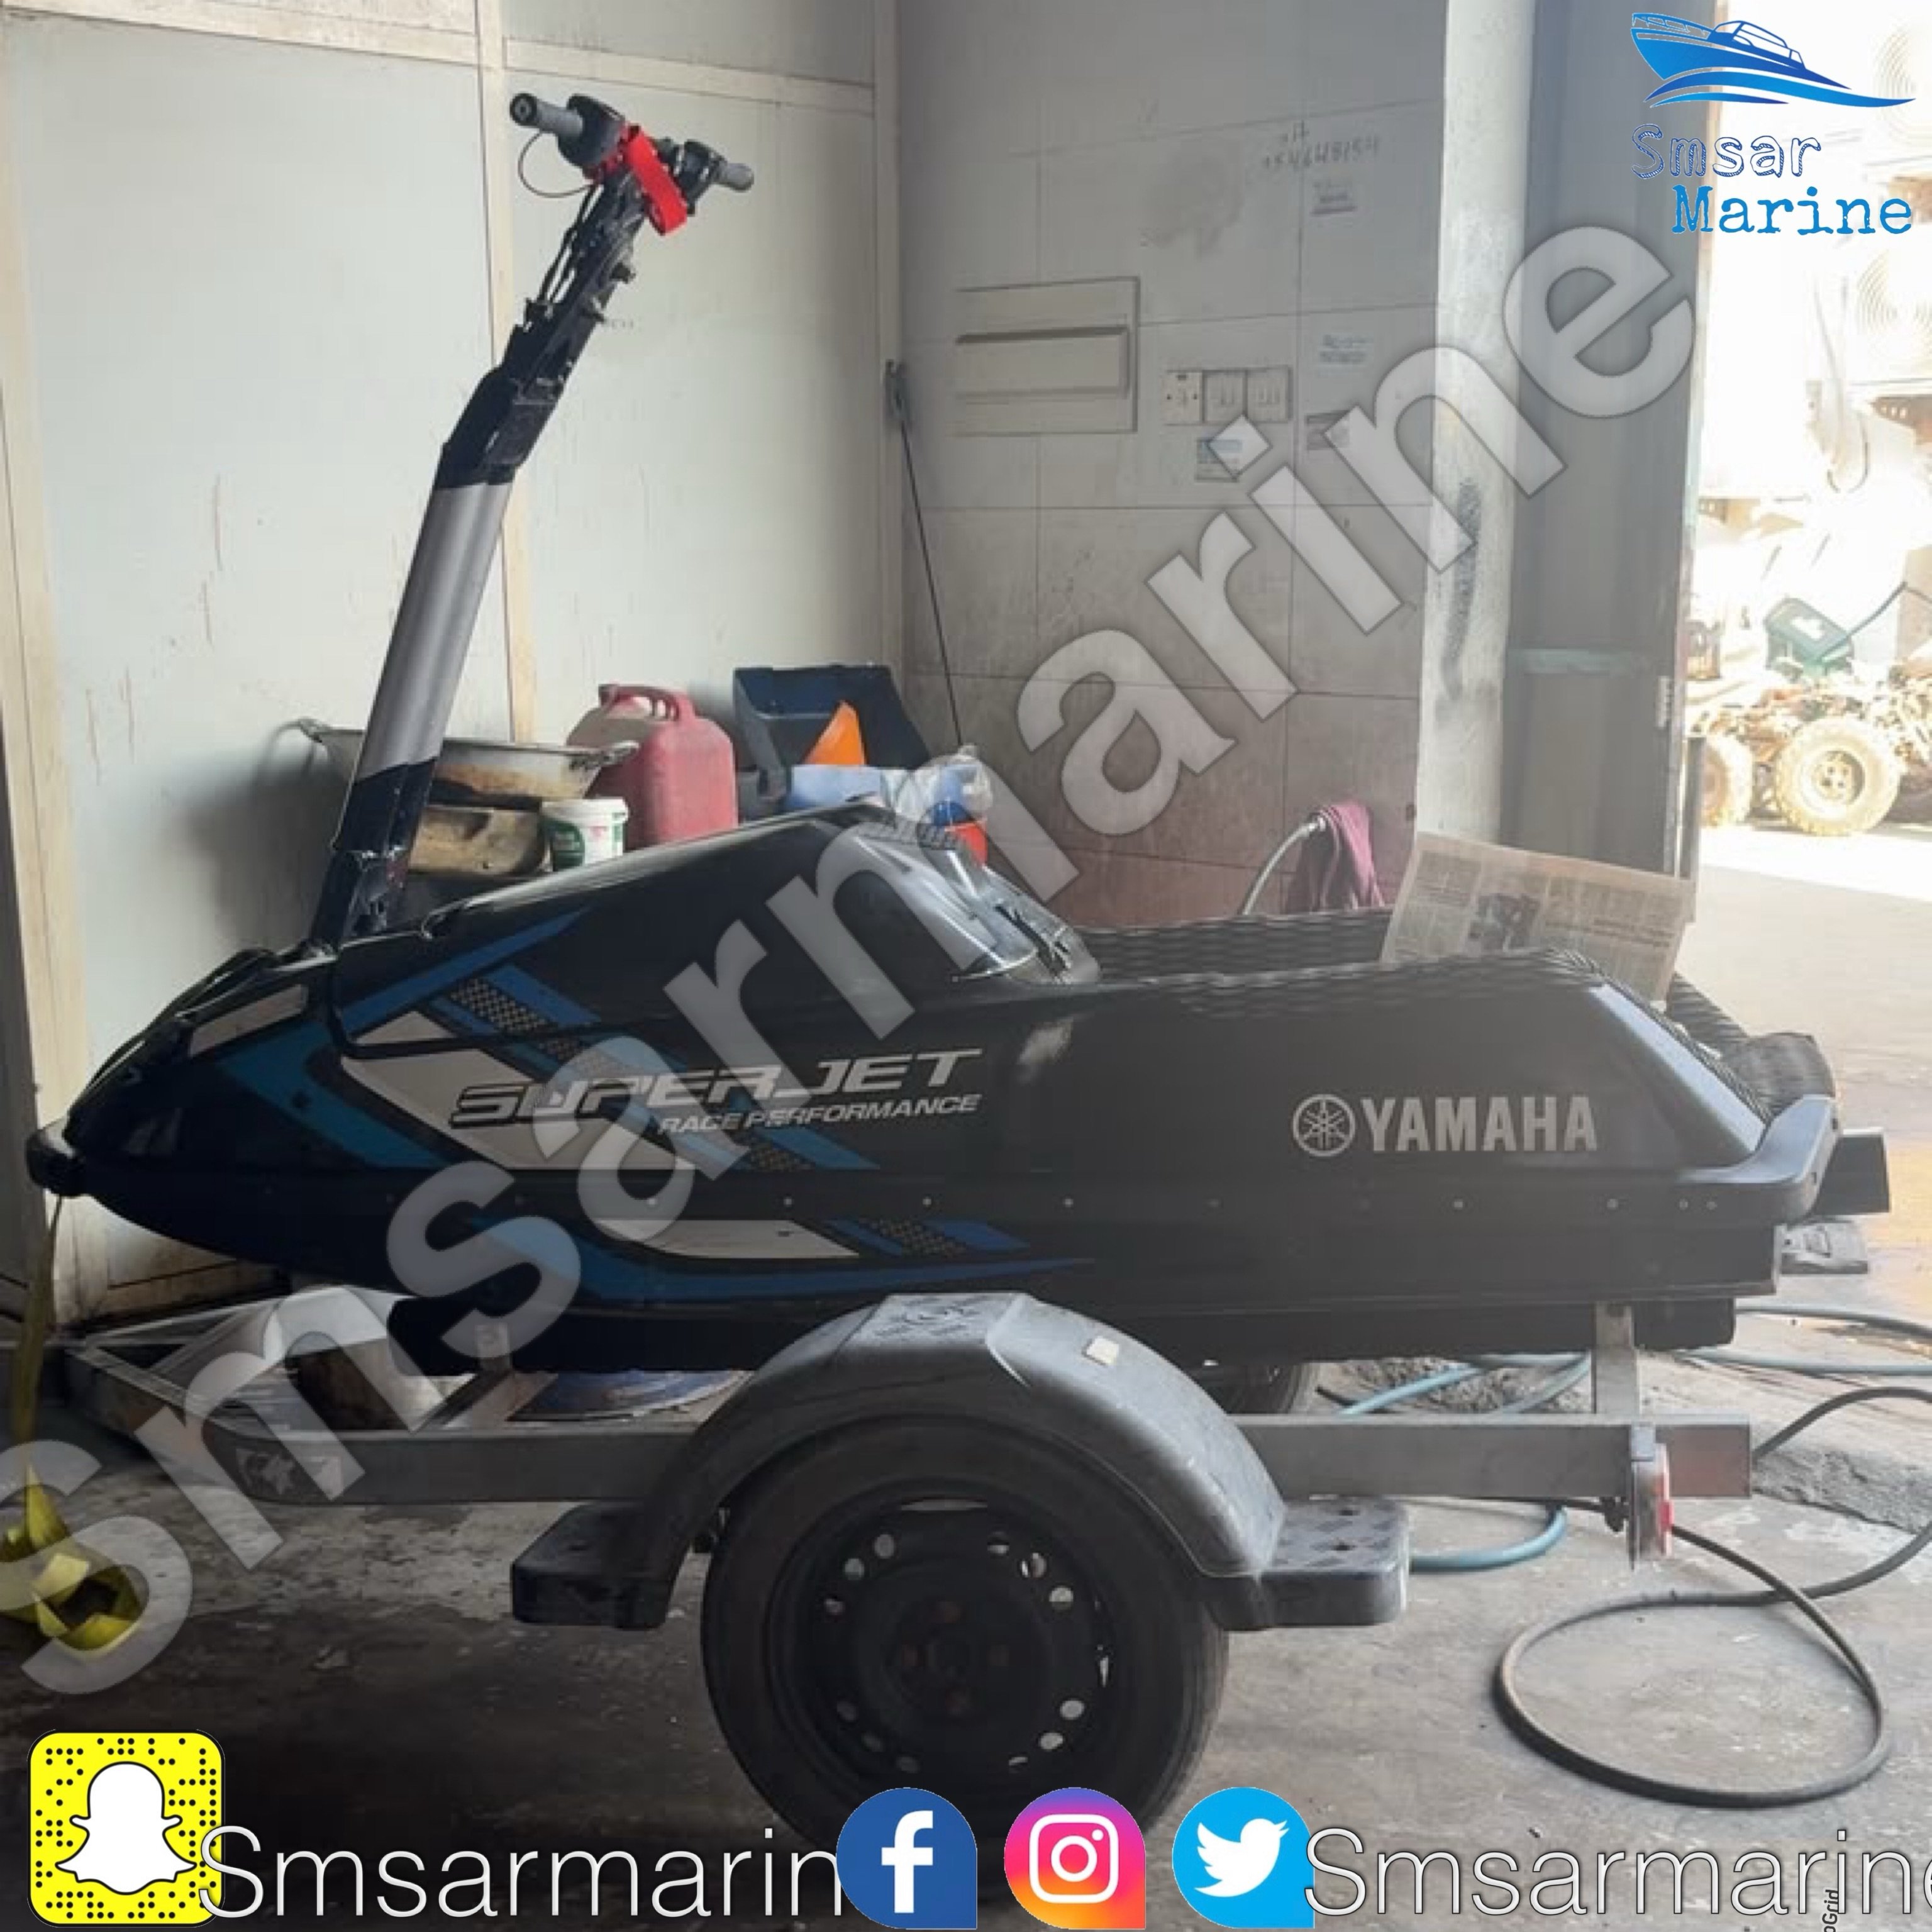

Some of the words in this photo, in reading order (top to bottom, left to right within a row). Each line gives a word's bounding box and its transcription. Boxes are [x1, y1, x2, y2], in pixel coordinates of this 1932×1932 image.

[660, 1111, 742, 1134] RACE
[745, 1094, 982, 1128] PERFORMANCE
[1360, 1097, 1597, 1152] YAMAHA
